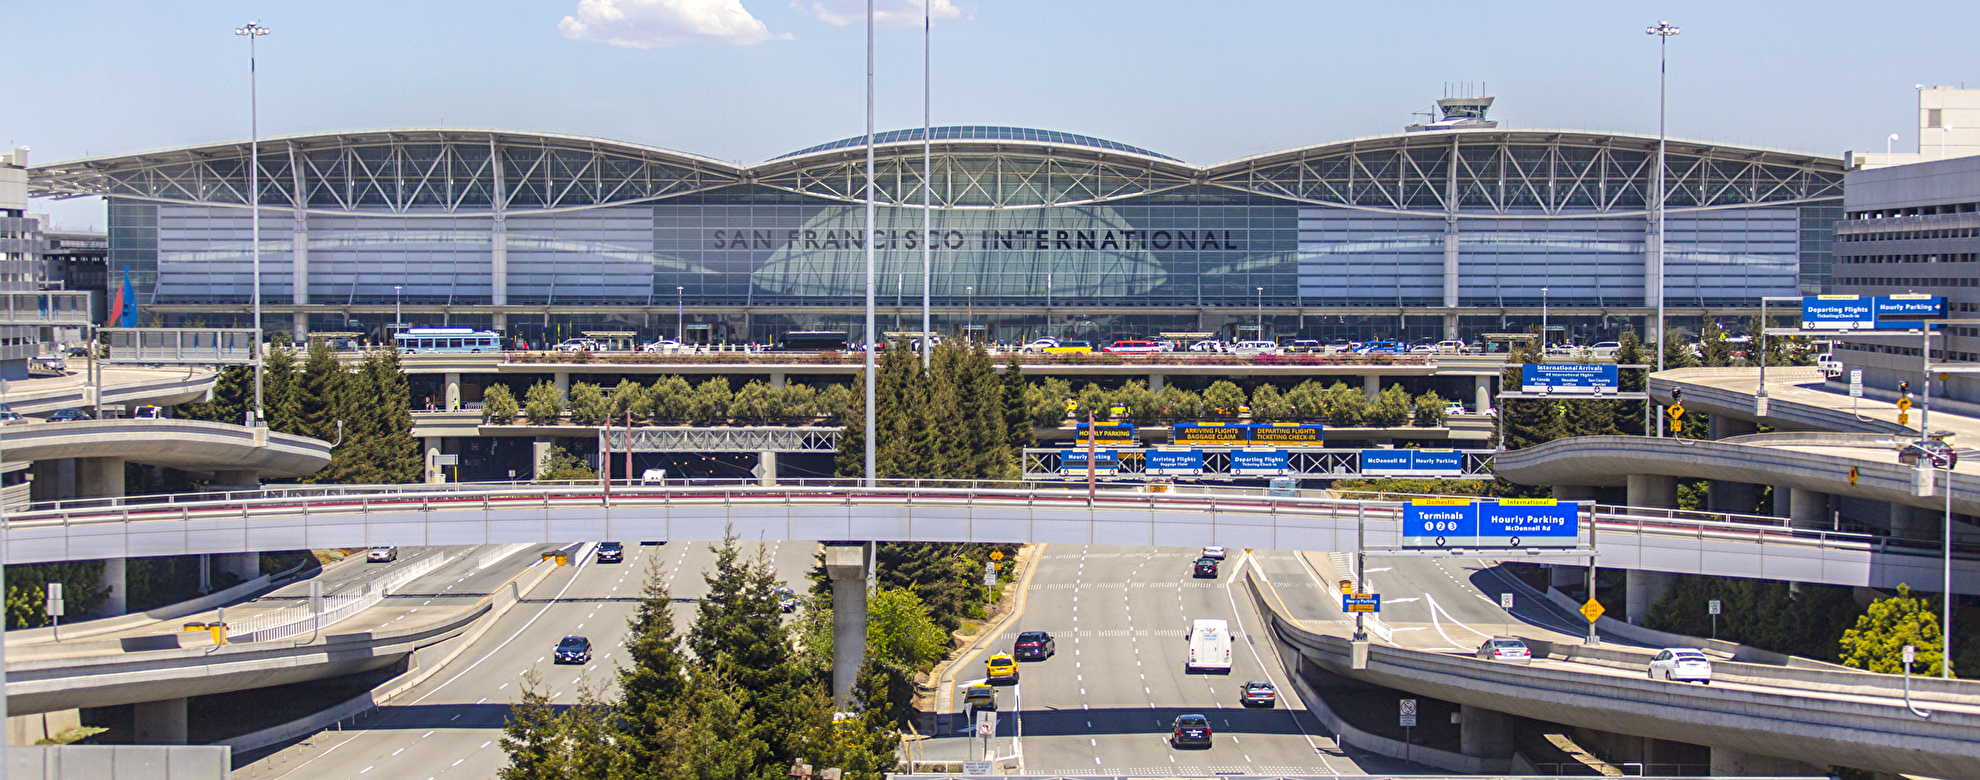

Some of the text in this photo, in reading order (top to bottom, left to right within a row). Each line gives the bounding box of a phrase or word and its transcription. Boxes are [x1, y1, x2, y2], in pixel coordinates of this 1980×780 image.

[714, 230, 1238, 250] SAN FRANCISCO INTERNATIONAL
[1492, 516, 1565, 525] Hourly Parking
